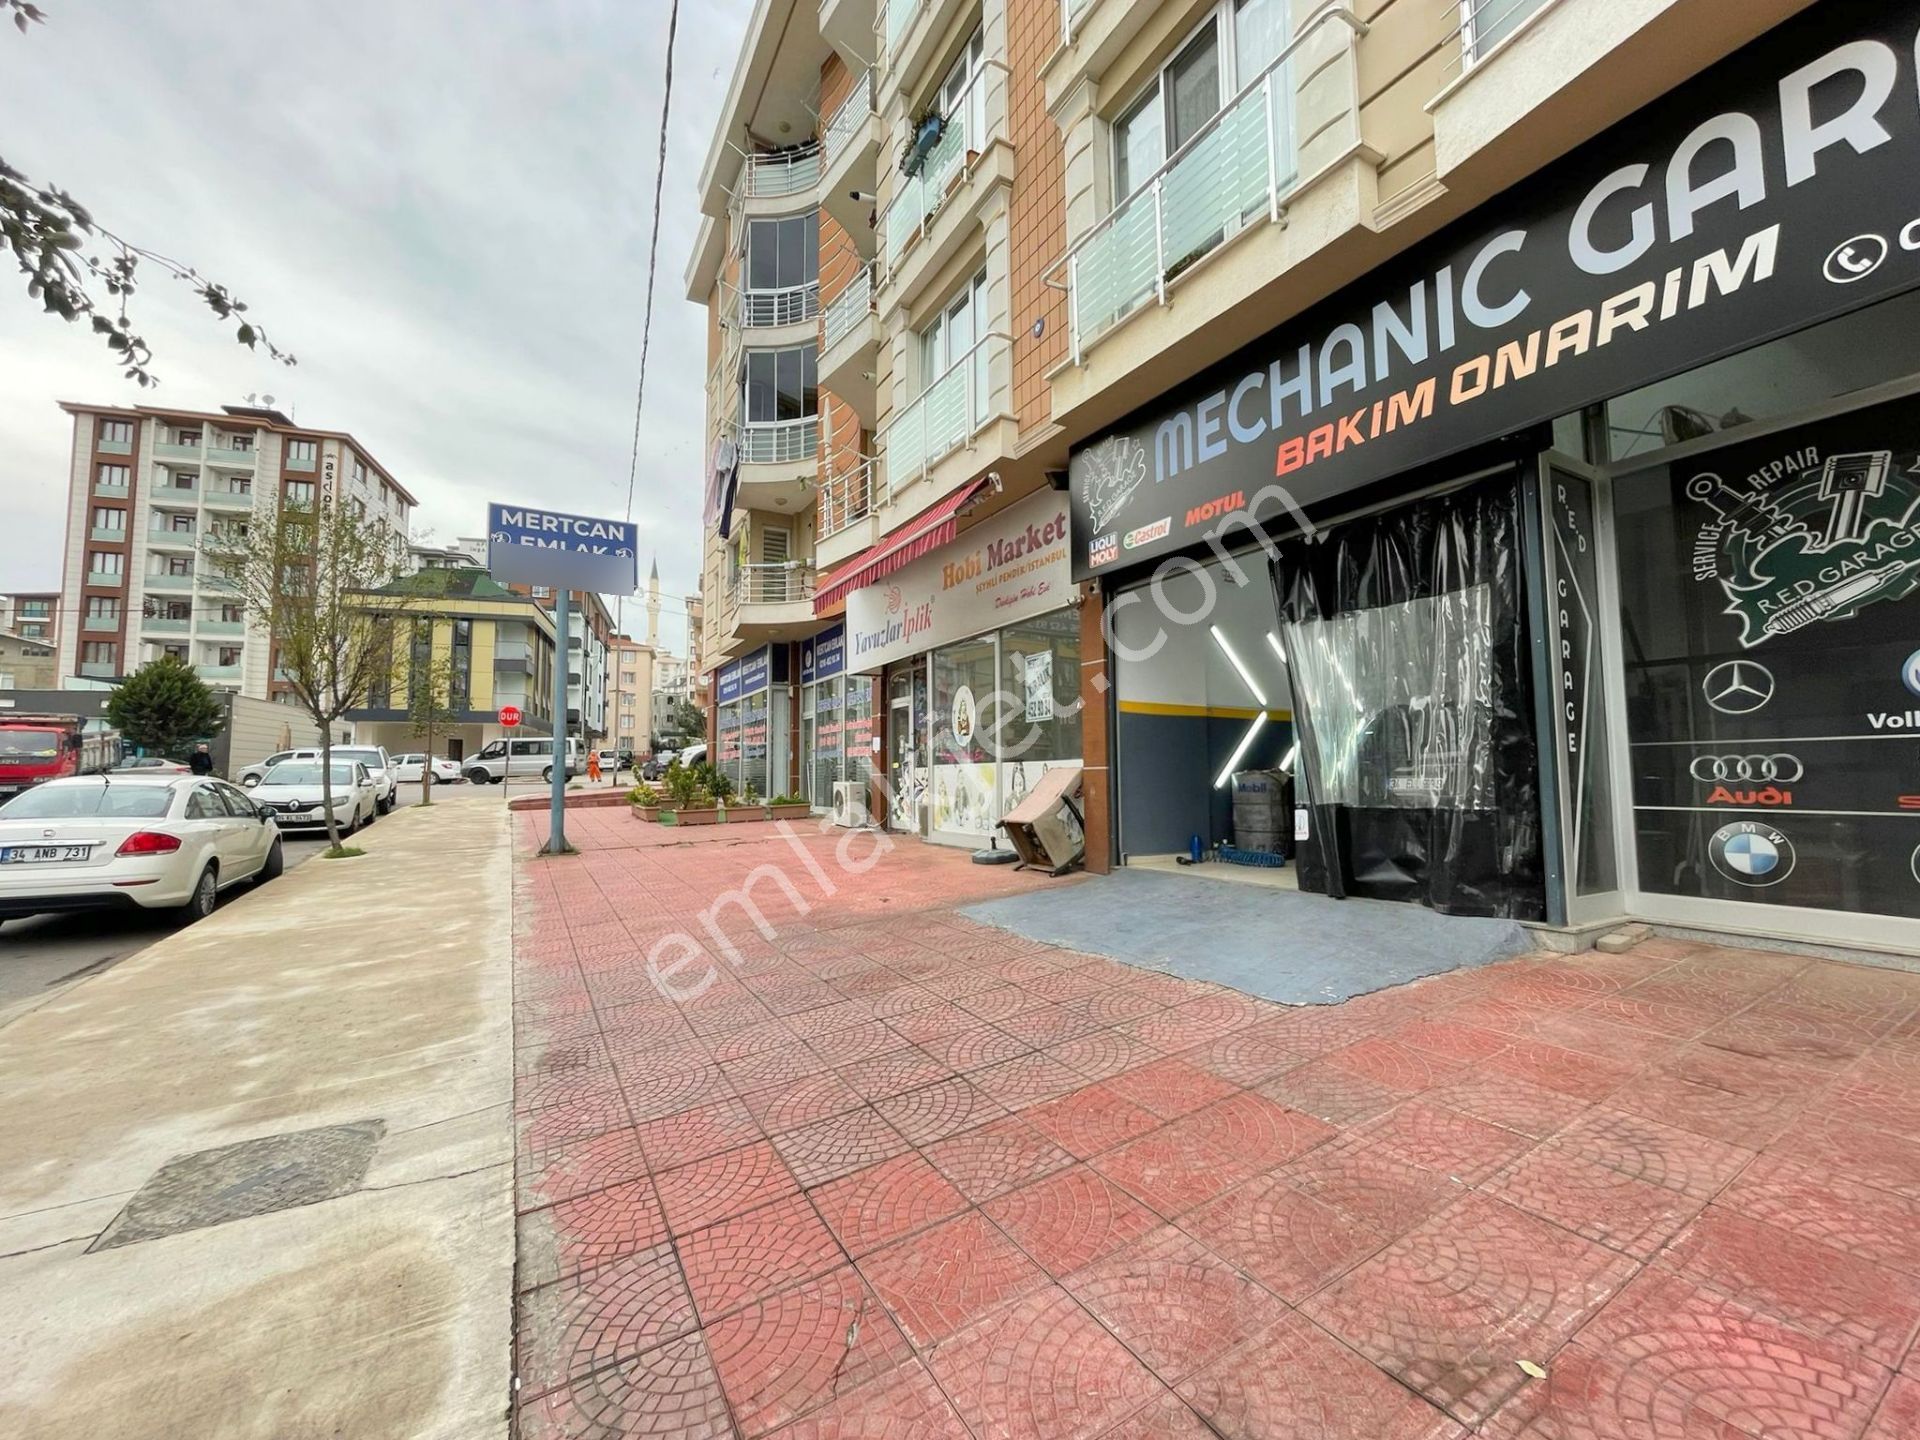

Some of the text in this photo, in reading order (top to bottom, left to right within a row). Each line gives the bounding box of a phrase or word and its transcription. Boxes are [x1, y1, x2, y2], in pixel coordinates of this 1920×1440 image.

[1155, 28, 1920, 483] MECHANIC GAR
[1747, 446, 1820, 491] REPAIR
[1185, 490, 1245, 527] MOTUL
[501, 509, 624, 541] MERTCAN
[1134, 520, 1167, 546] Castrol
[942, 511, 1066, 591] Hobi Market
[1090, 535, 1116, 553] LIQUI
[1090, 547, 1117, 567] MOLY
[1693, 523, 1724, 581] SERVICE
[1757, 580, 1815, 615] R.E.D
[1558, 578, 1577, 752] GARAGE
[500, 712, 520, 721] DUR
[1238, 782, 1267, 793] Mobil
[1706, 786, 1792, 805] Audi
[1717, 823, 1785, 846] BMW
[11, 847, 87, 860] 34 ANB 731
